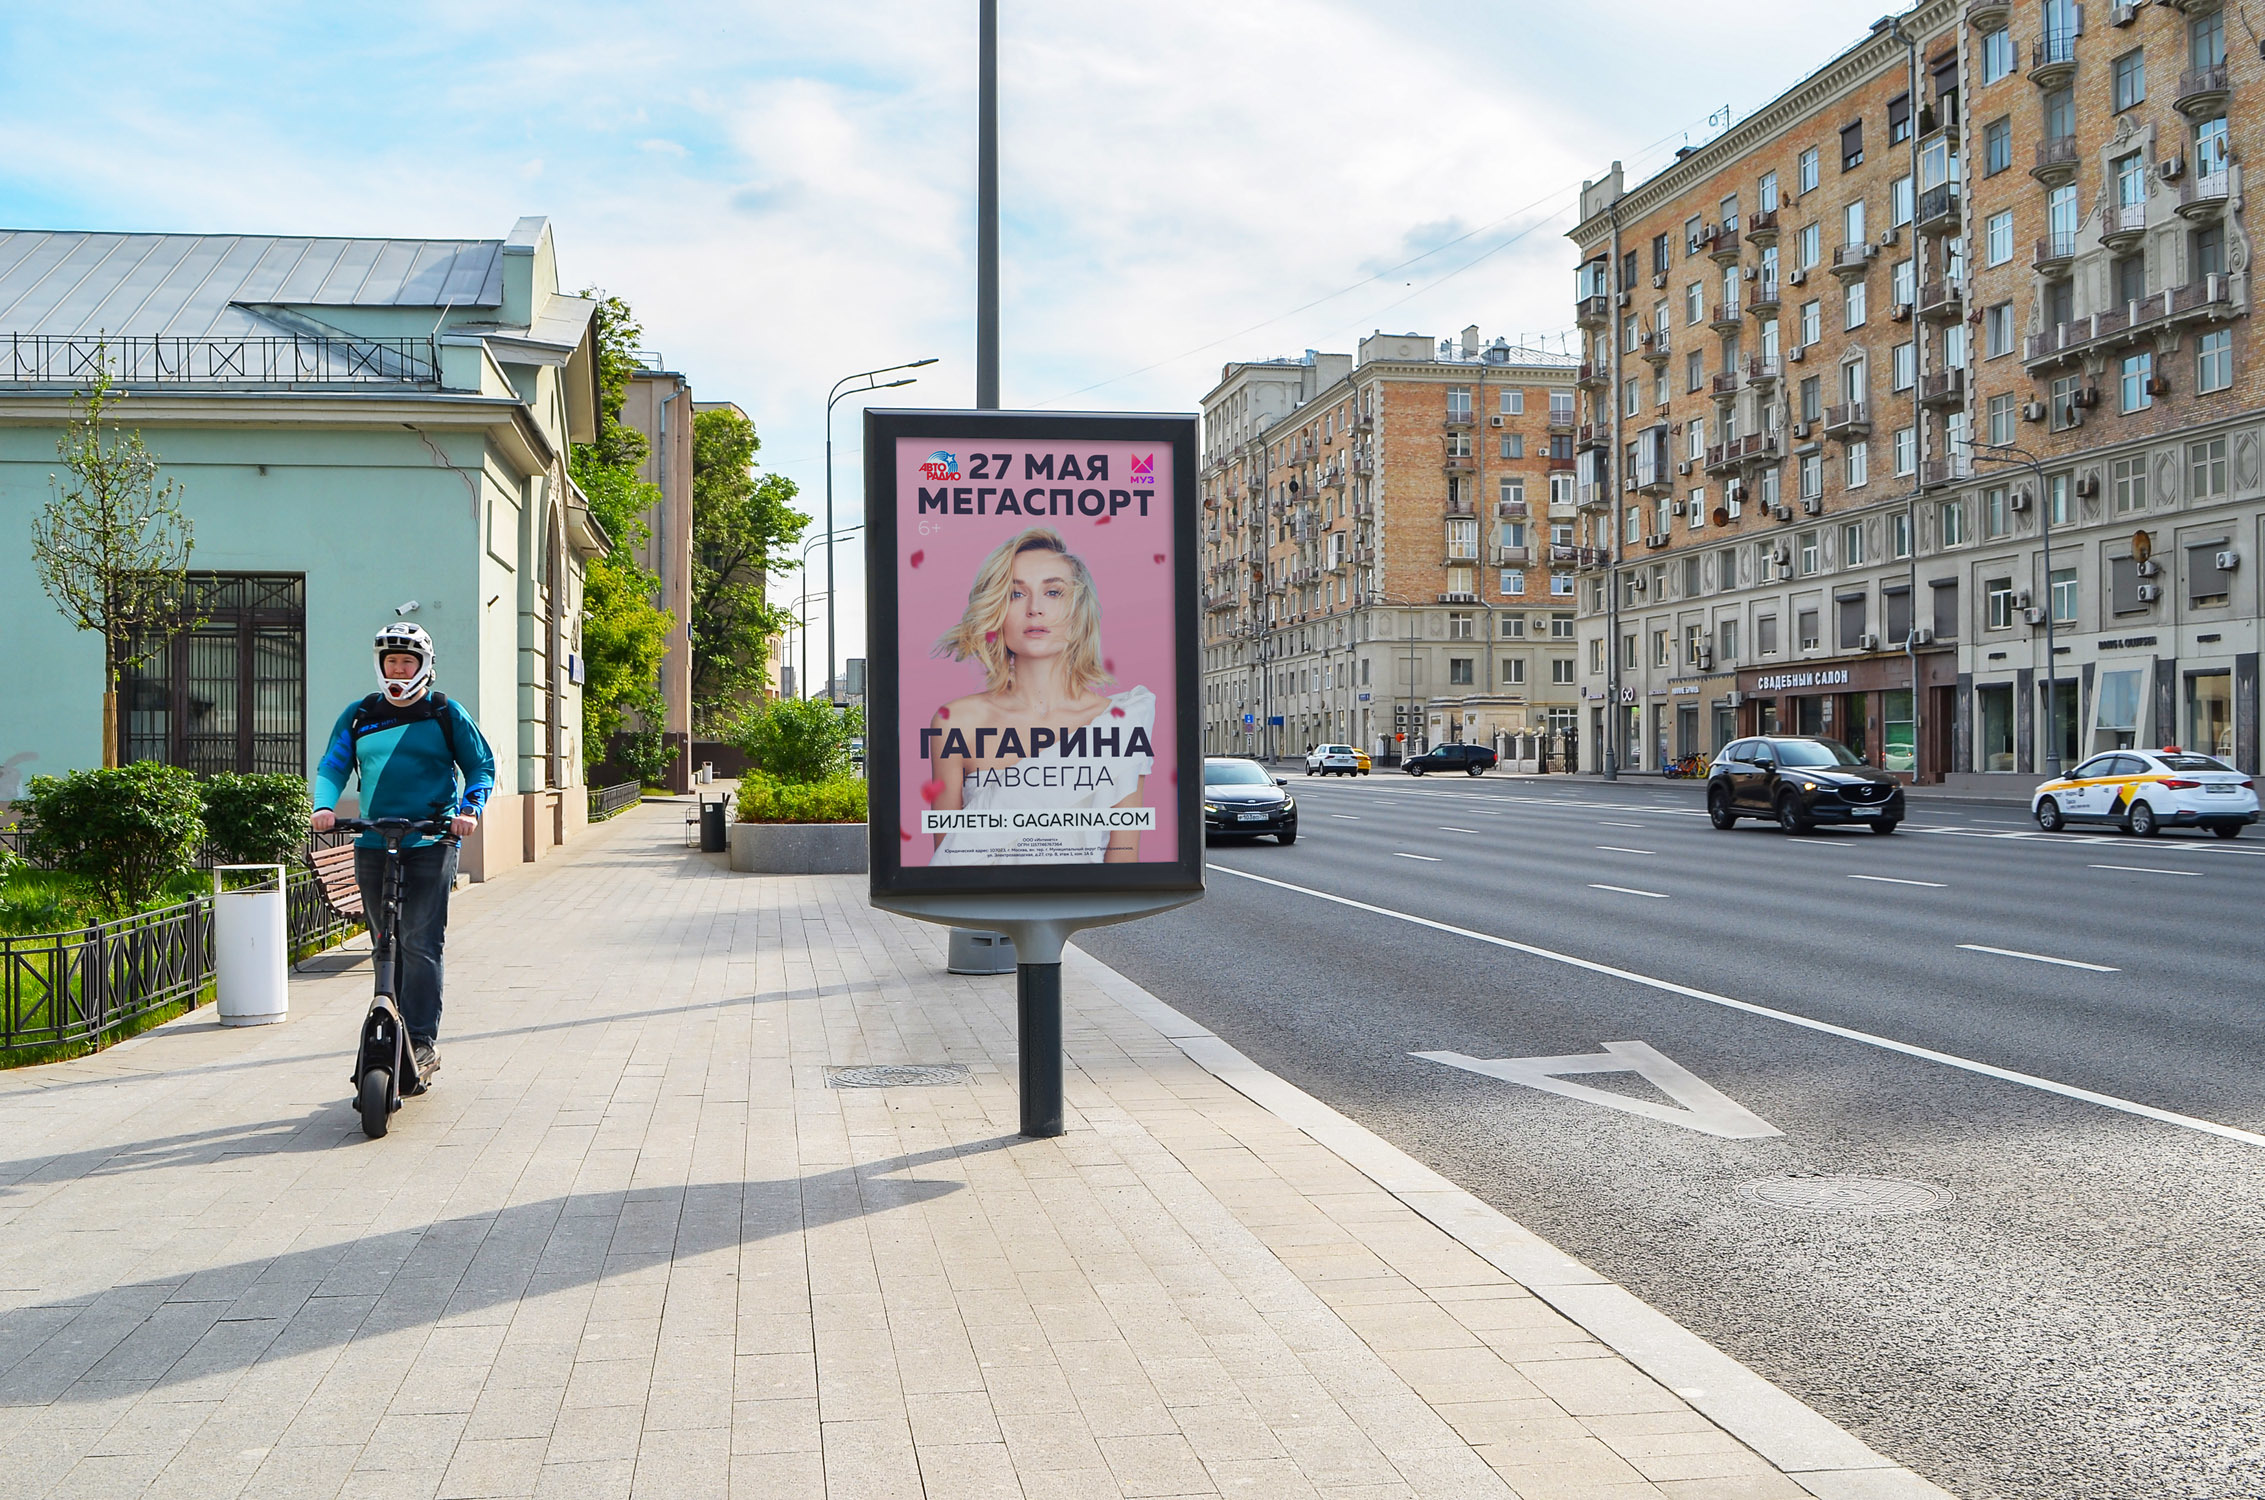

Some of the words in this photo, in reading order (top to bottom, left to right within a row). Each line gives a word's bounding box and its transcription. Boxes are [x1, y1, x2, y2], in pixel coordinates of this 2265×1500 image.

[918, 462, 946, 472] АВТО
[969, 453, 1012, 480] 27
[1024, 454, 1108, 481] МАЯ
[926, 472, 961, 481] РАДИО
[1130, 476, 1154, 484] МУЗ
[918, 487, 1154, 517] МЕГАСПОРТ
[918, 520, 941, 536] 6+
[1758, 672, 1812, 690] СВАДЕБНЫЙ
[1815, 670, 1848, 686] САЛОН
[920, 726, 1154, 759] ГАГАРИНА
[962, 766, 1114, 790] НАВСЕГДА
[928, 814, 1008, 828] БИЛЕТЫ:
[1012, 812, 1150, 828] GAGARINA.COM
